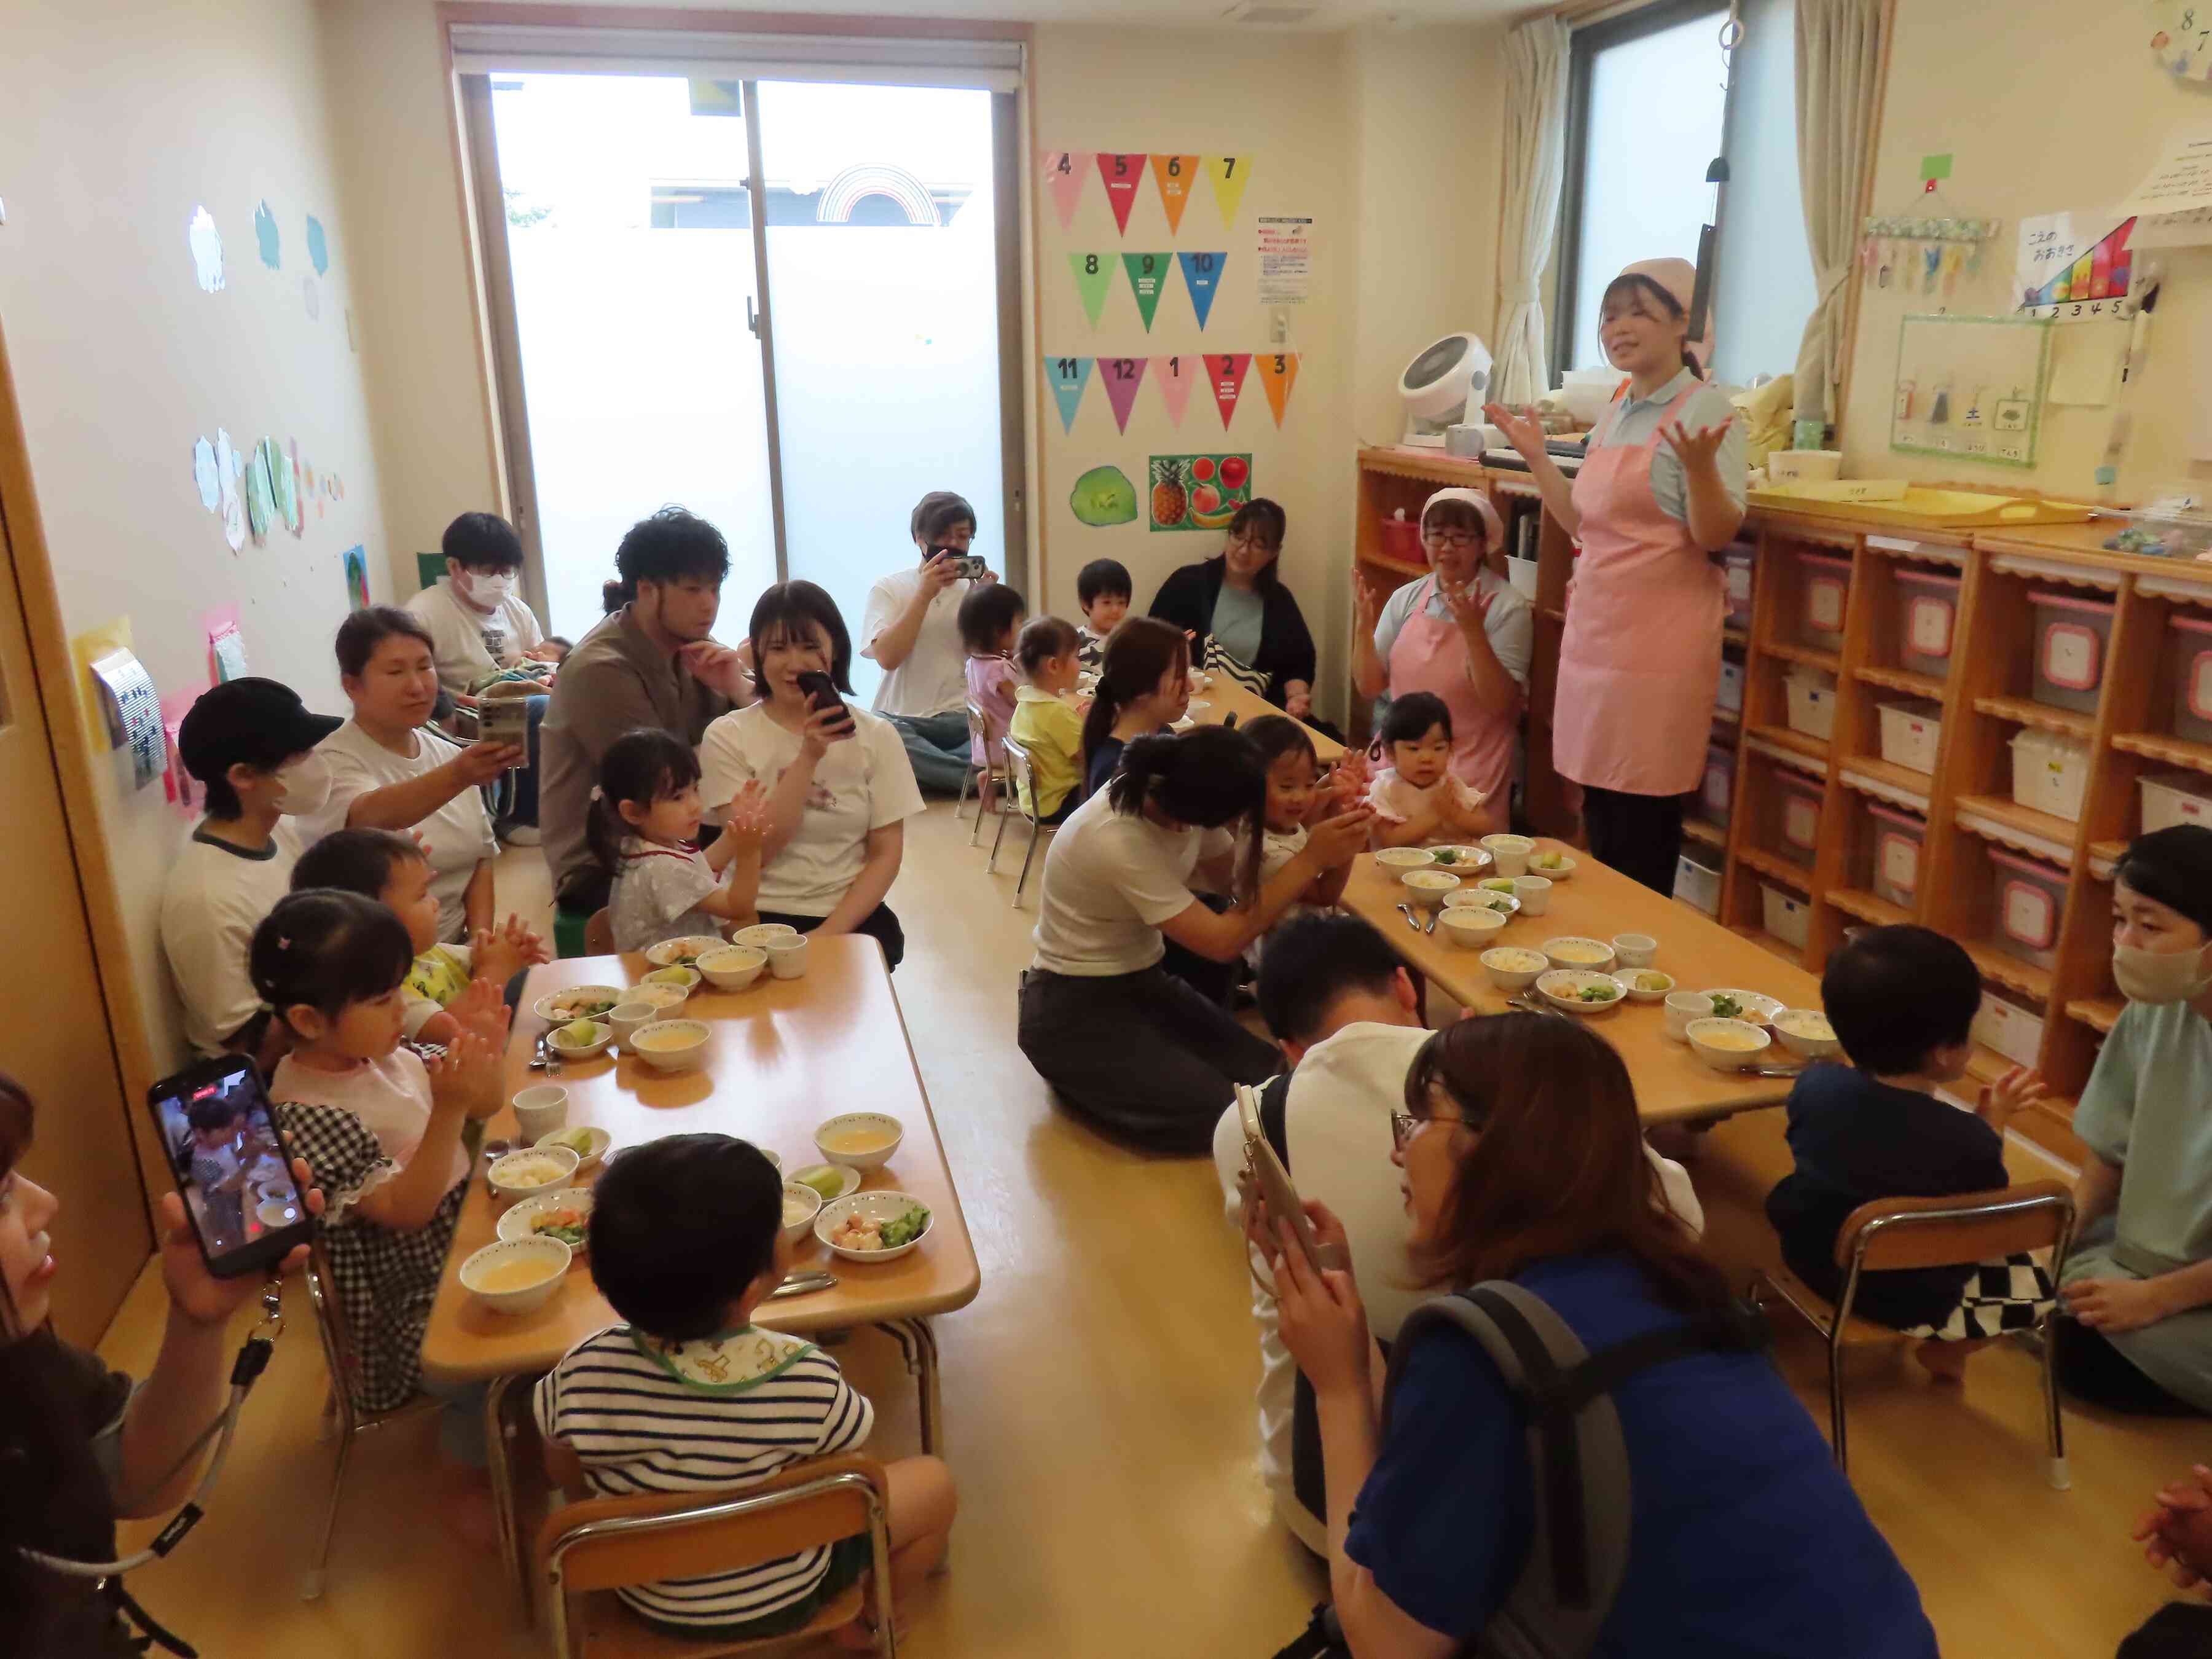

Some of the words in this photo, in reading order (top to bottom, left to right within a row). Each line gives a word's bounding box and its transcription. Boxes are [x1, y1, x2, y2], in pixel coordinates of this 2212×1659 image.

[2182, 9, 2194, 30] 8
[2198, 31, 2210, 51] 7
[1057, 153, 1072, 175] 4
[1115, 155, 1128, 176] 5
[1168, 156, 1180, 177] 6
[1223, 157, 1236, 179] 7
[2028, 231, 2057, 246] こえの
[1190, 253, 1214, 273] 10
[2034, 244, 2074, 262] おおきさ
[1085, 254, 1099, 275] 8
[1142, 254, 1155, 275] 9
[2031, 308, 2036, 317] 1
[2050, 307, 2060, 318] 2
[2071, 304, 2082, 316] 3
[2091, 302, 2102, 315] 4
[2111, 300, 2123, 313] 5
[1057, 358, 1078, 379] 11
[1112, 358, 1135, 380] 12
[1169, 356, 1179, 377] 1
[1222, 355, 1234, 375] 2
[1274, 354, 1286, 374] 3
